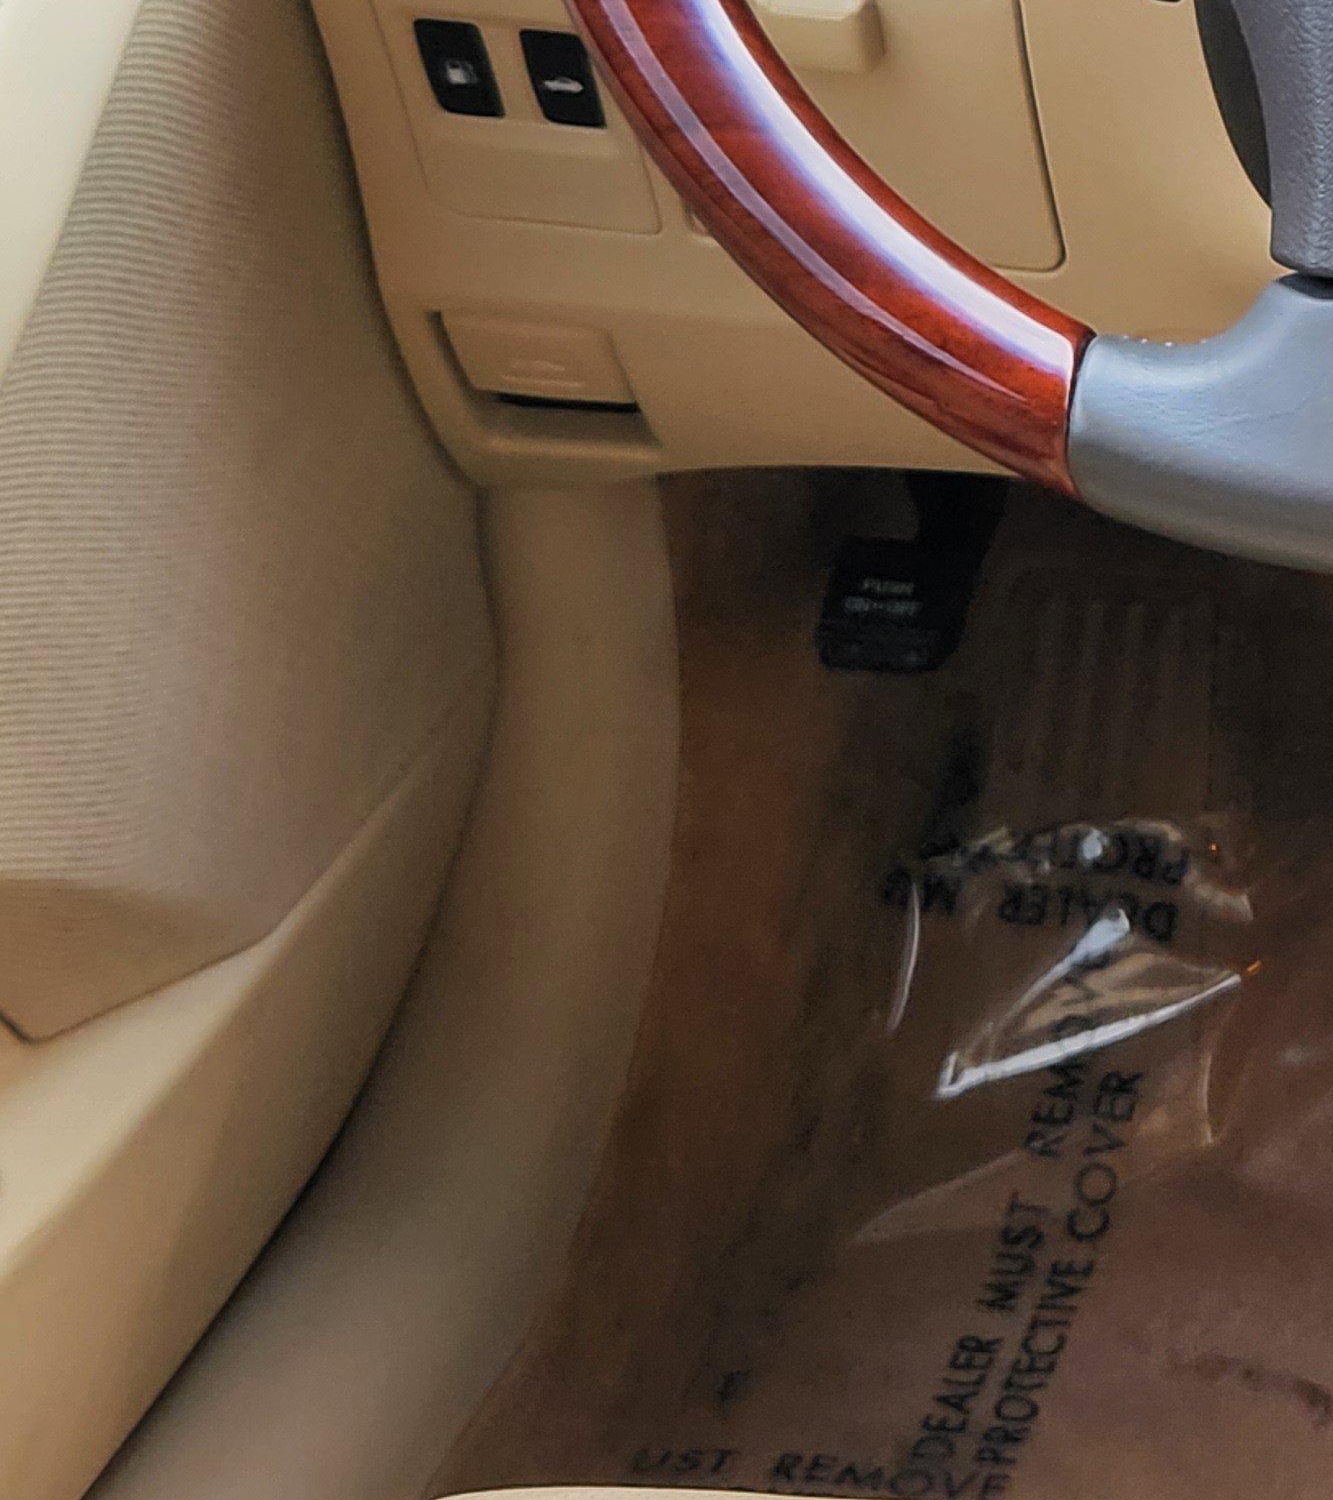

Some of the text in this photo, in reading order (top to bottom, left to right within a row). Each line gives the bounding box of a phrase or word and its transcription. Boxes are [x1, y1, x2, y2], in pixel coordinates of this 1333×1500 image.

[911, 1334, 1001, 1462] DEALER
[977, 1190, 1048, 1312] MUST
[975, 1070, 1142, 1466] PROTECTIVE COVER
[629, 1448, 739, 1475] UST
